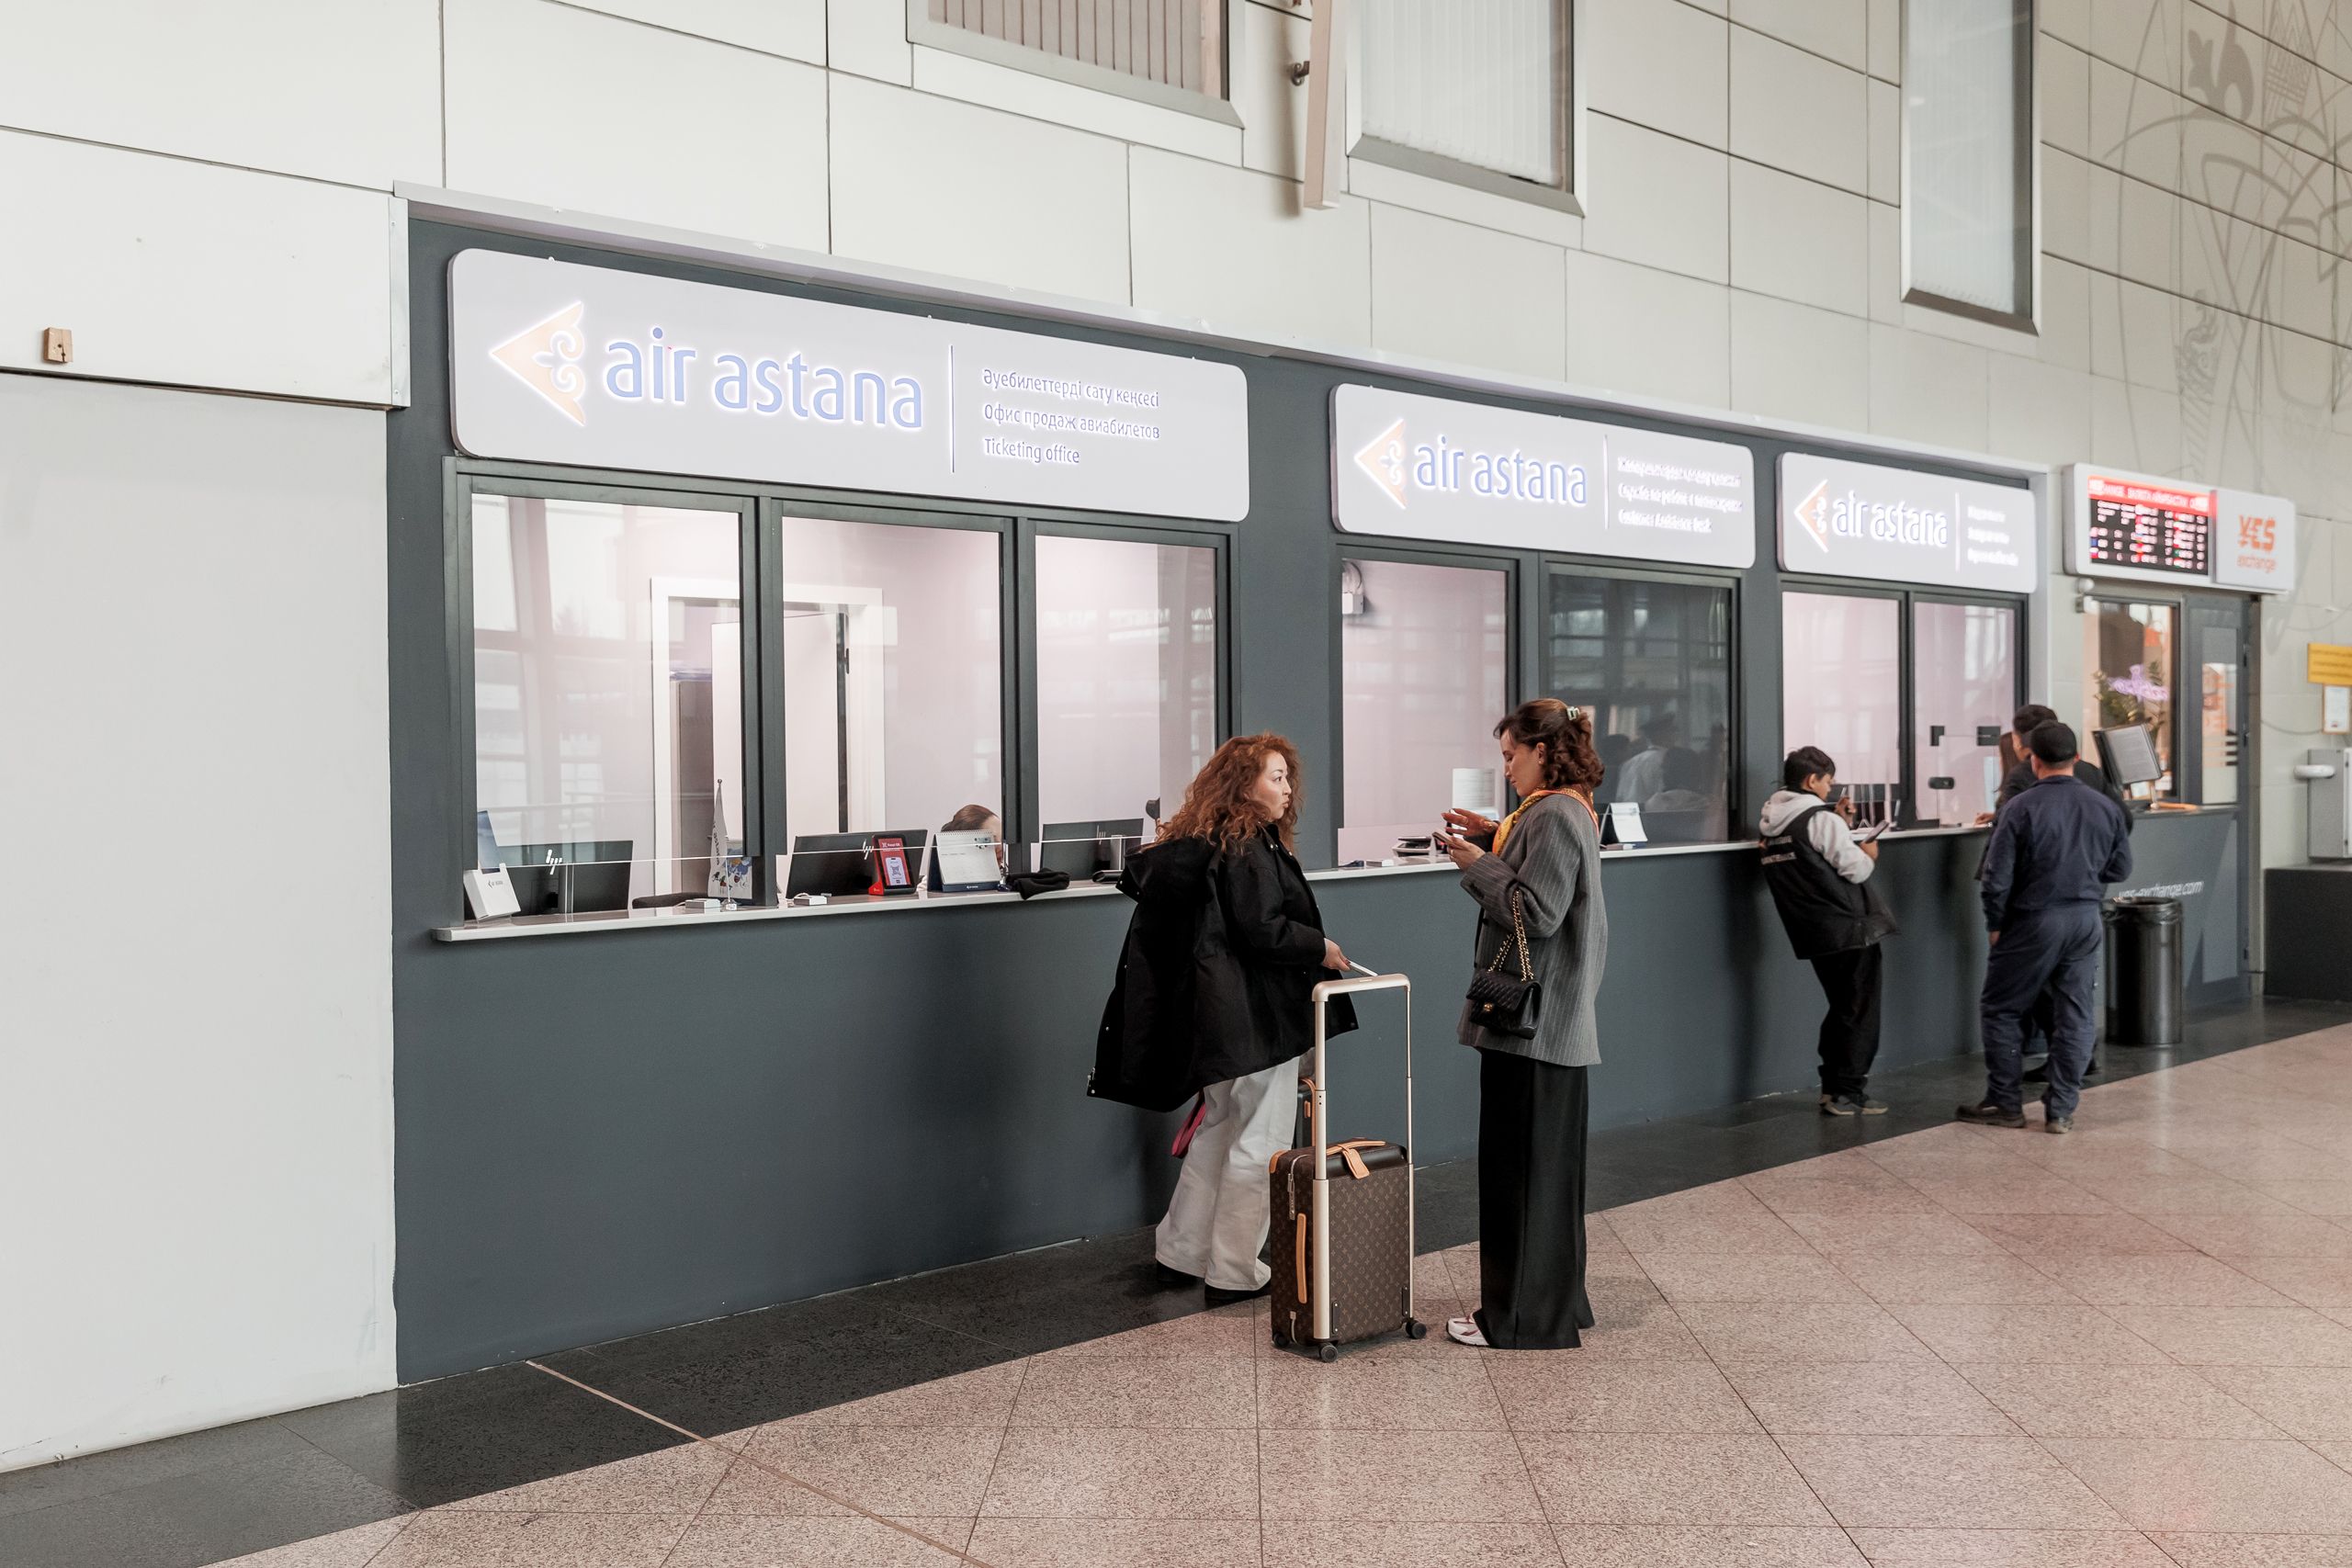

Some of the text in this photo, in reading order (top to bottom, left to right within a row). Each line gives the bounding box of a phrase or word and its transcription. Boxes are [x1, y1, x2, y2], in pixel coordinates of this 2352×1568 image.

[605, 327, 923, 429] air astana
[983, 367, 1159, 407] Әуебилеттерді сату кеңсесі
[983, 402, 1160, 439] Офис продаж авиабилетов
[984, 438, 1080, 463] Ticketing office
[1415, 434, 1464, 491] air
[1473, 449, 1589, 504] astana
[1832, 491, 1948, 547] air astana
